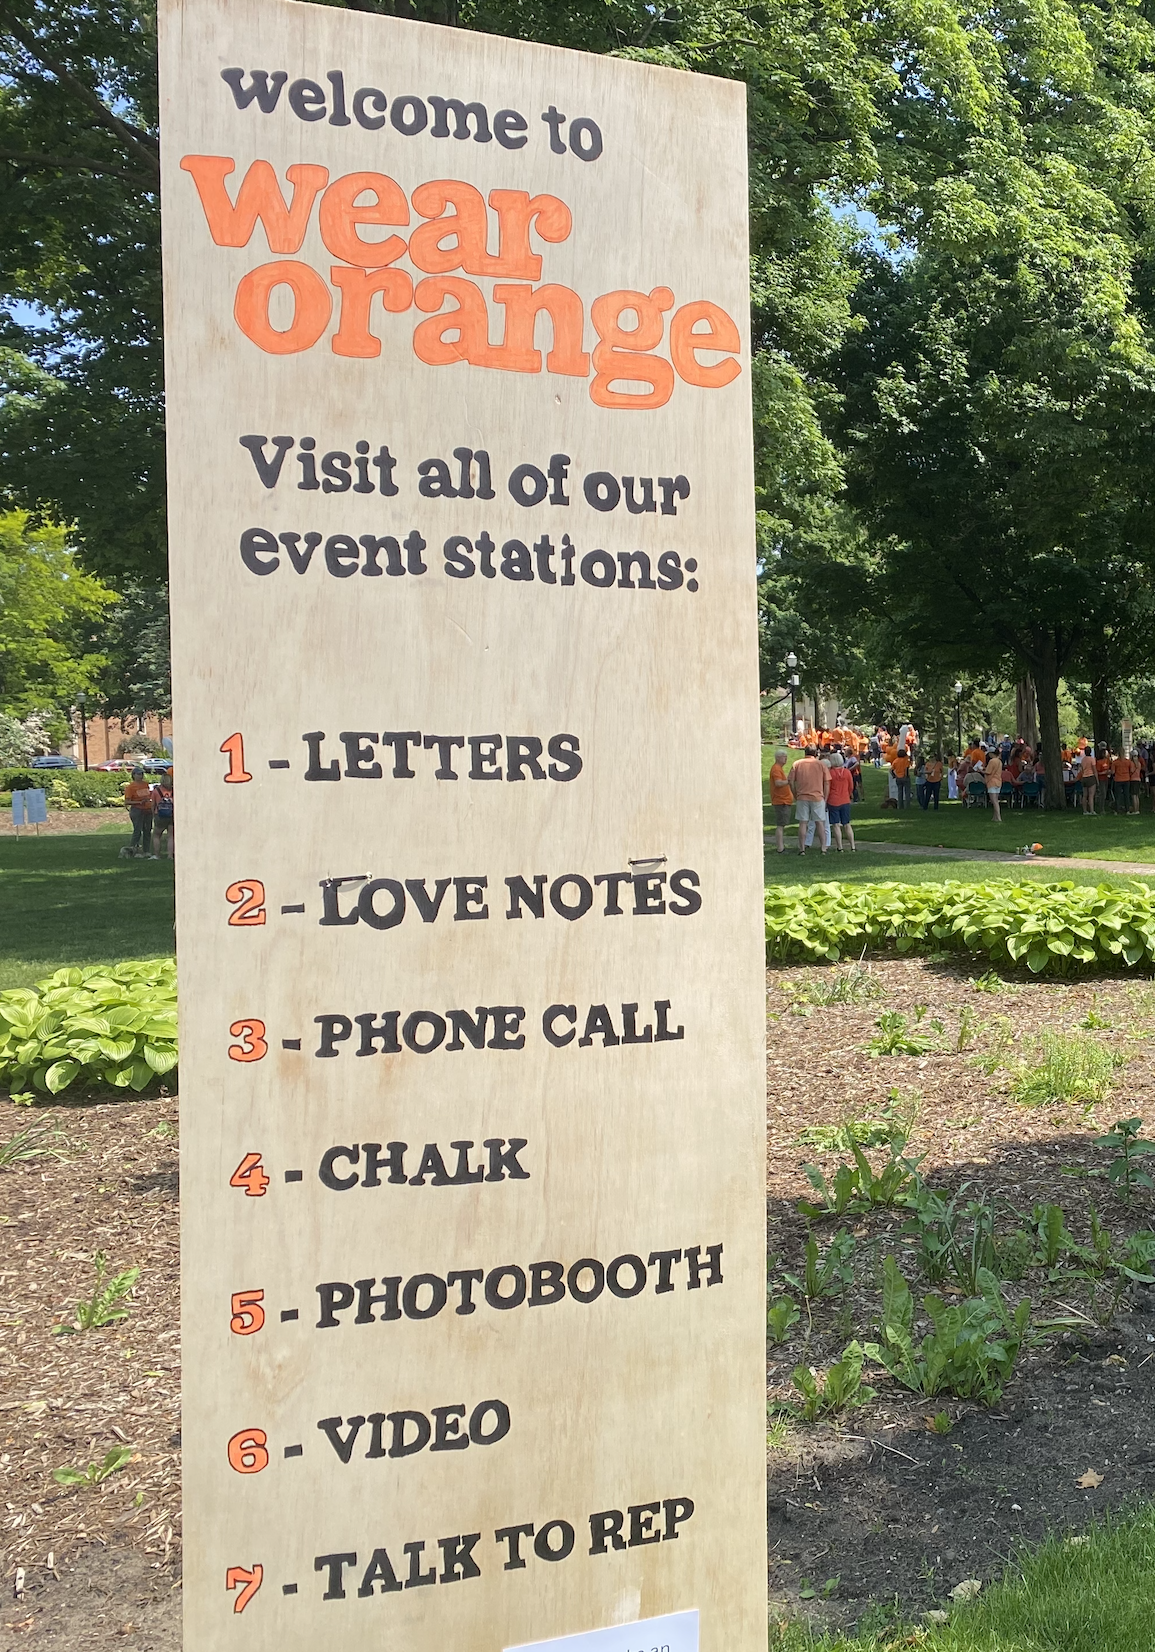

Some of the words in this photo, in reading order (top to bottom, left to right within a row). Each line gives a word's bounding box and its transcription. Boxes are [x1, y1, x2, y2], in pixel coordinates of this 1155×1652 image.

[221, 67, 528, 150] welcome
[541, 106, 604, 162] to
[180, 154, 573, 281] wear
[233, 260, 743, 411] orange
[239, 435, 399, 497] Visit
[417, 447, 496, 500] all
[508, 454, 571, 508] of
[583, 471, 692, 516] our
[239, 527, 428, 578] event
[443, 534, 700, 593] stations:
[219, 731, 253, 784] 1
[302, 730, 584, 783] LETTERS
[225, 879, 267, 927] 2
[318, 875, 490, 931] LOVE
[504, 867, 703, 922] NOTES
[227, 1018, 269, 1063] 3
[313, 1005, 527, 1058] PHONE
[541, 999, 686, 1049] CALL
[229, 1152, 270, 1197] 4
[318, 1137, 531, 1192] CHALK
[229, 1288, 266, 1337] 5
[314, 1242, 725, 1330] PHOTOBOOTH
[227, 1428, 270, 1475] 6
[316, 1399, 512, 1464] VIDEO
[225, 1563, 264, 1615] 7
[313, 1532, 482, 1601] TALK
[494, 1519, 576, 1572] TO
[588, 1497, 696, 1556] REP
